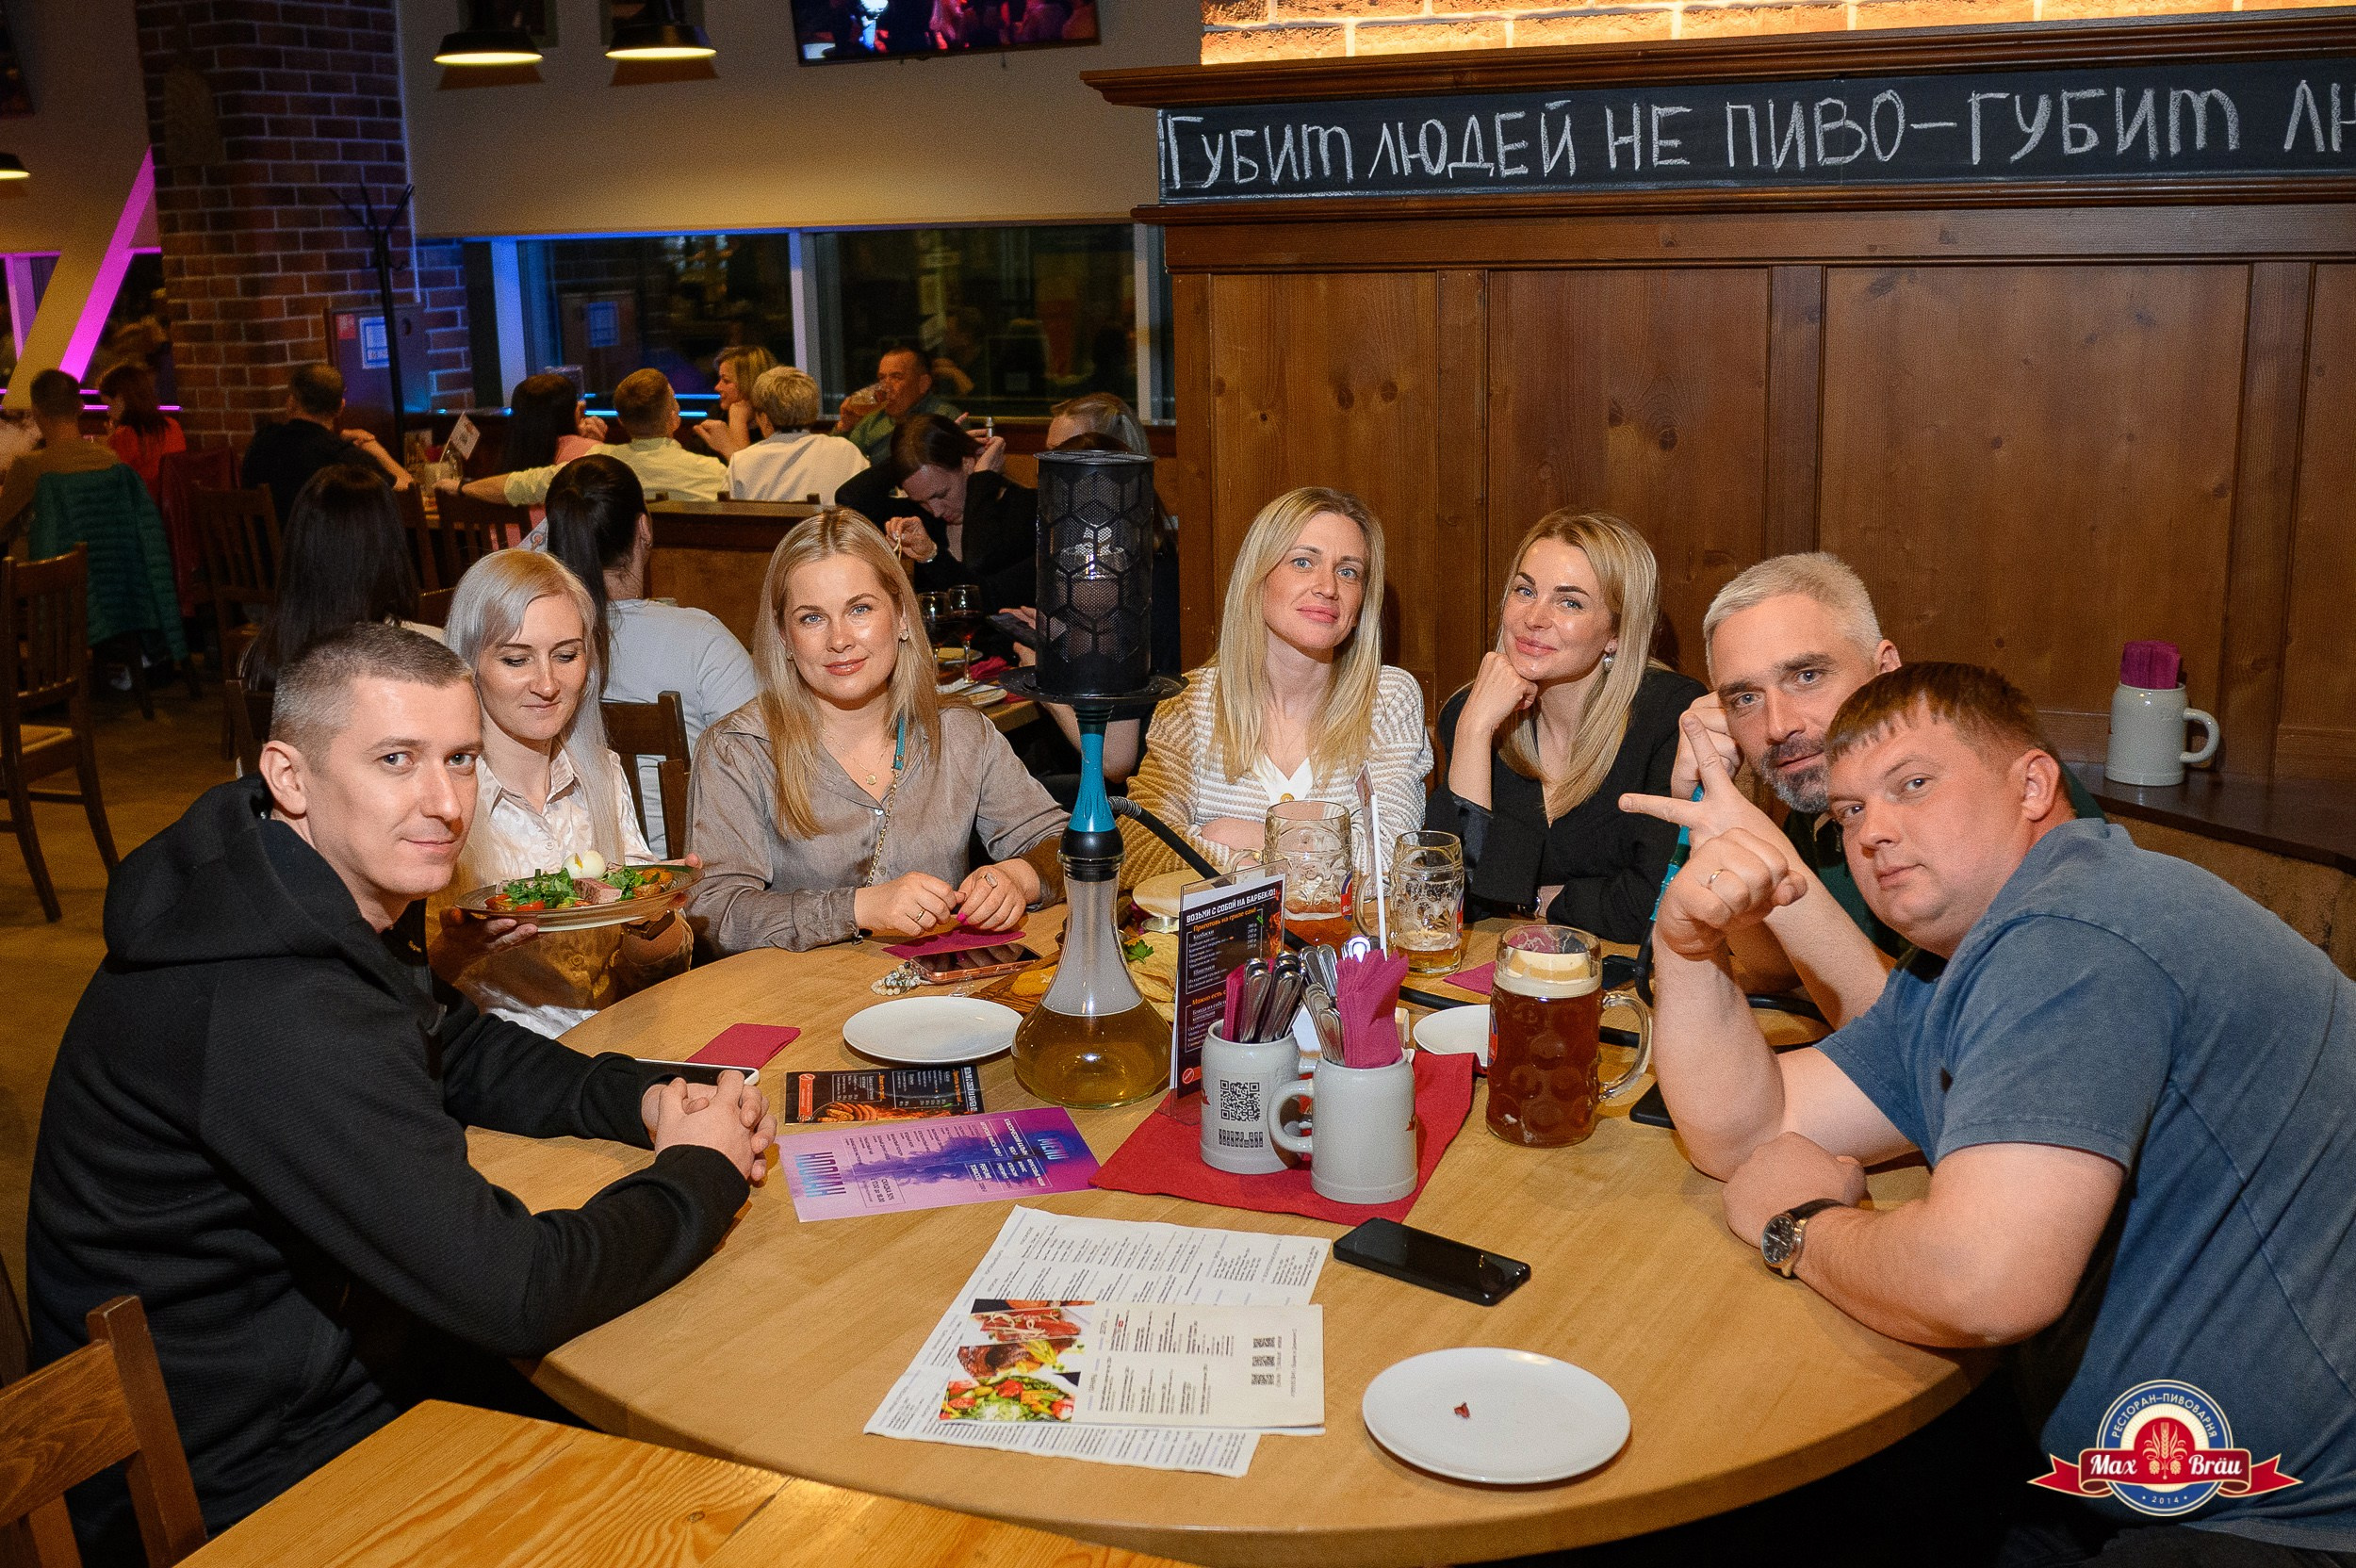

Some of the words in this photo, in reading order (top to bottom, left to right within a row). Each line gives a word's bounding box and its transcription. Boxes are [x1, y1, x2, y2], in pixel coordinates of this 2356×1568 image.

[1369, 100, 1577, 179] ЛЮДЕЙ
[1605, 102, 1693, 170] НЕ
[1186, 909, 1211, 923] ВОЗЬМИ
[1218, 899, 1236, 913] СОБОЙ
[1037, 1136, 1070, 1160] MENU
[794, 1152, 847, 1199] HOOKAH
